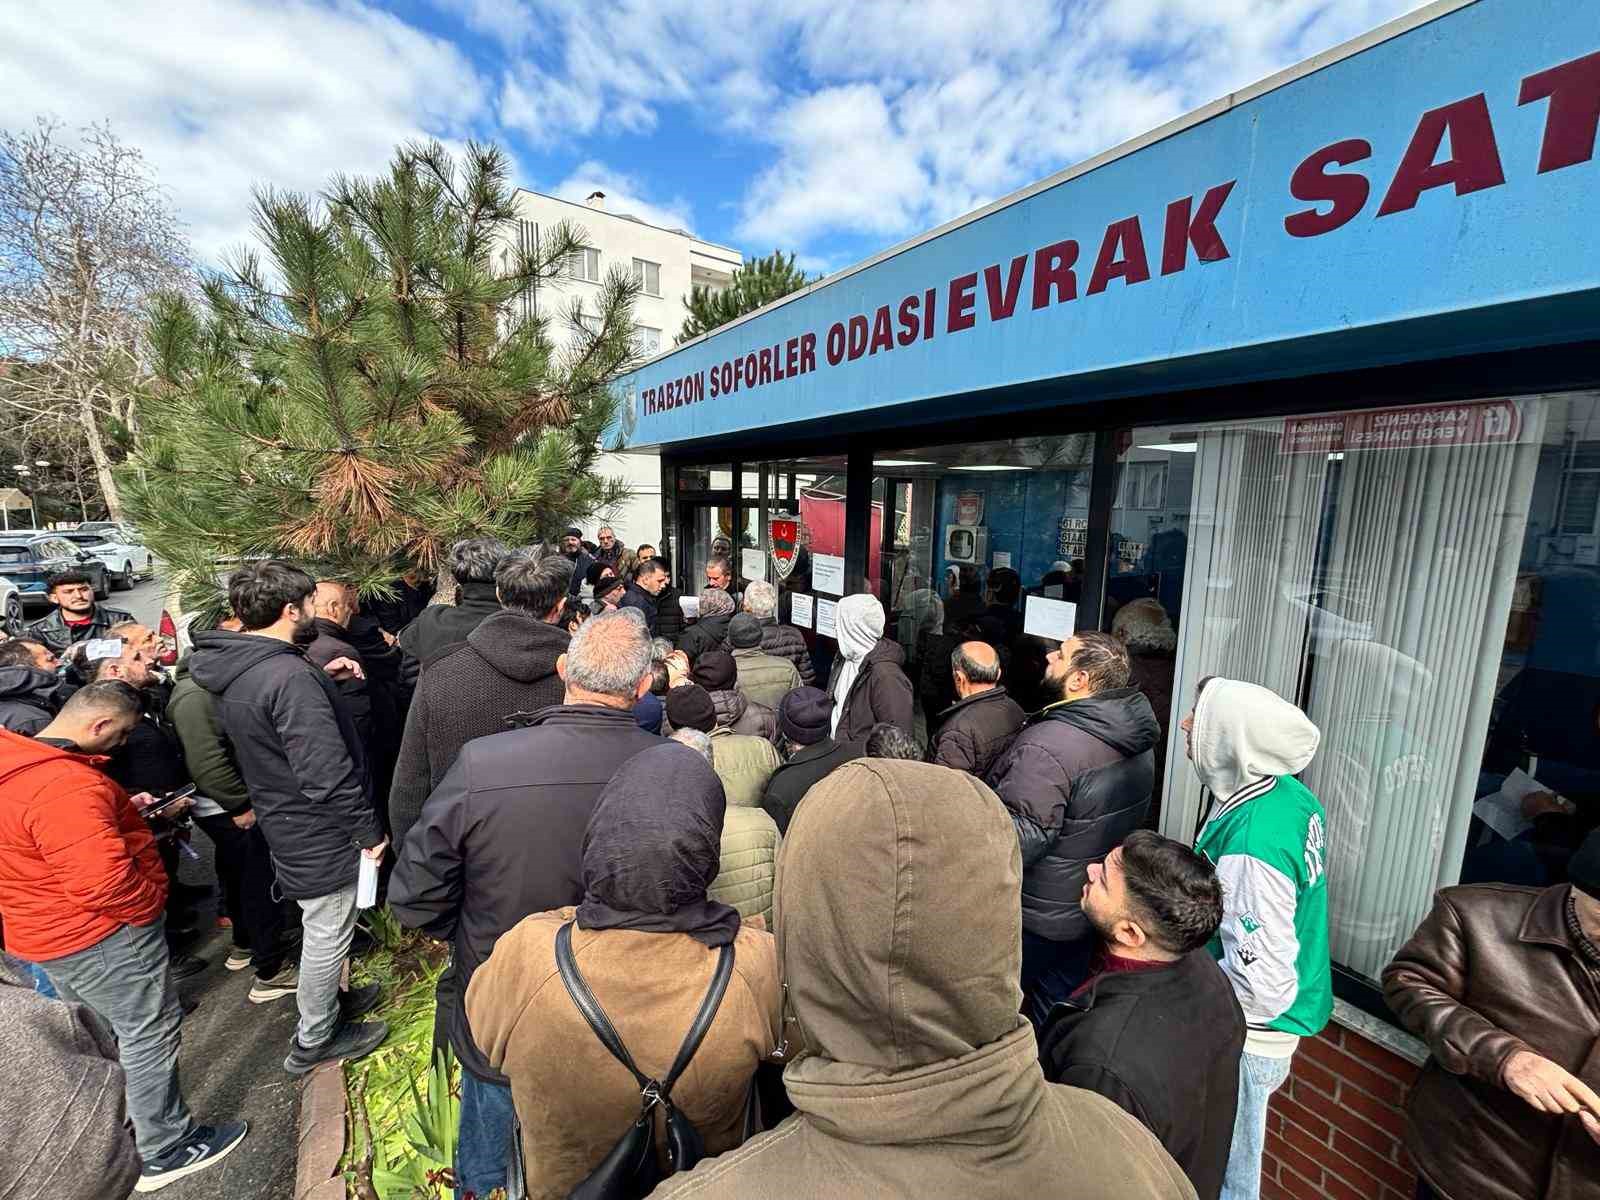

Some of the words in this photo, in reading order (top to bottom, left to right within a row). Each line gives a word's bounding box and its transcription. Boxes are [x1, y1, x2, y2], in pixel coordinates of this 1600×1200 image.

[642, 371, 705, 417] TRABZON
[826, 287, 937, 366] ODASI
[946, 179, 1238, 333] EVRAK
[1283, 50, 1600, 238] SAT
